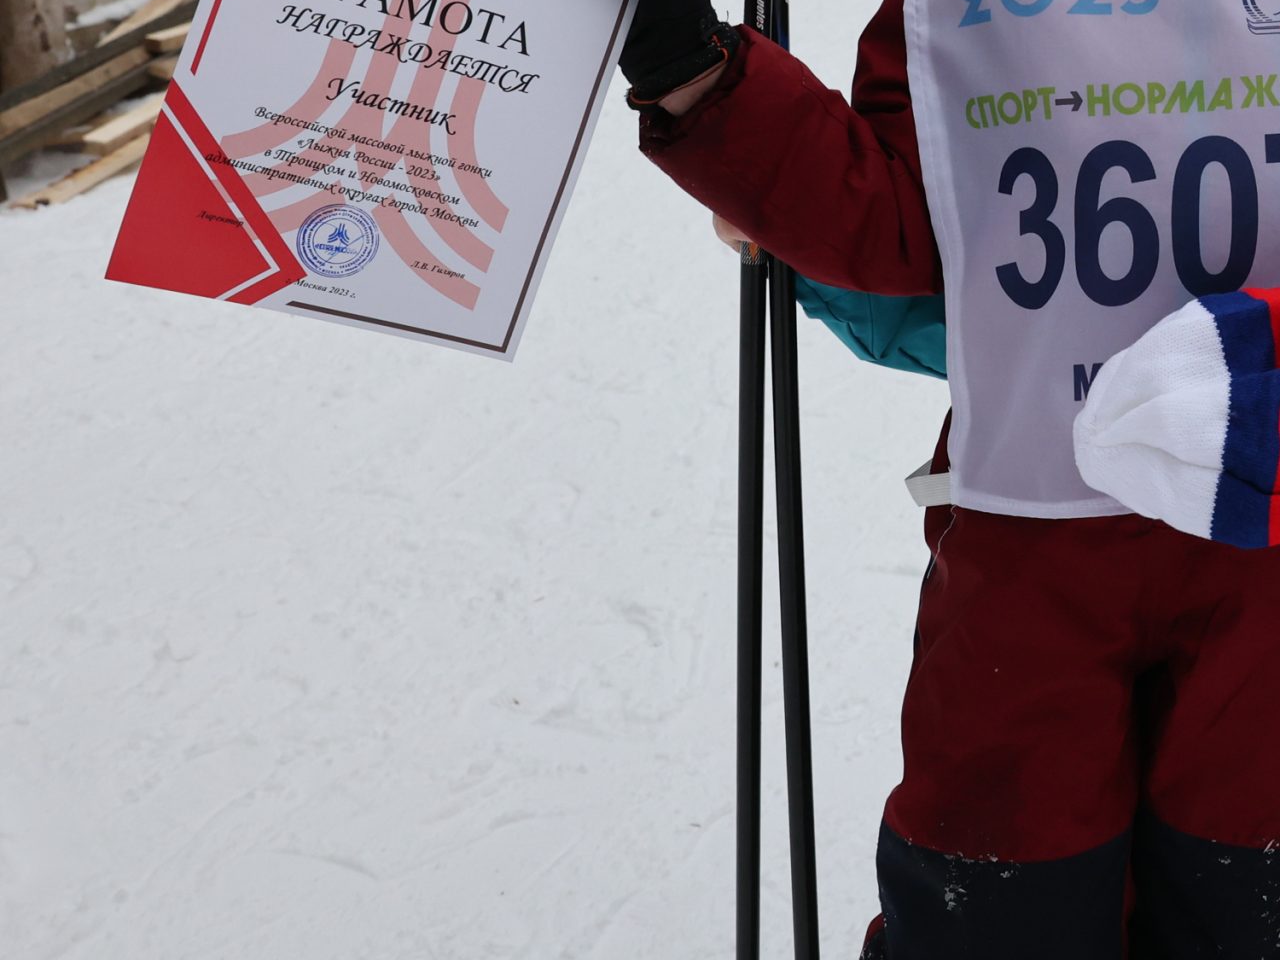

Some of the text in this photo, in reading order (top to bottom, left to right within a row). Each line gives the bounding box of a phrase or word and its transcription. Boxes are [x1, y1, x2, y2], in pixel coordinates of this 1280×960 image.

[275, 5, 541, 94] НАГРАЖДАЕТСЯ
[325, 77, 457, 136] Участник
[966, 87, 1055, 129] СПОРТ
[1087, 79, 1233, 117] НОРМА
[254, 106, 493, 178] Всероссийской массовой лыжной гонки
[353, 151, 396, 171] России
[205, 151, 480, 228] административных округах города Москвы
[263, 149, 461, 206] в Троицком и Новомосковском
[328, 286, 350, 297] 2023
